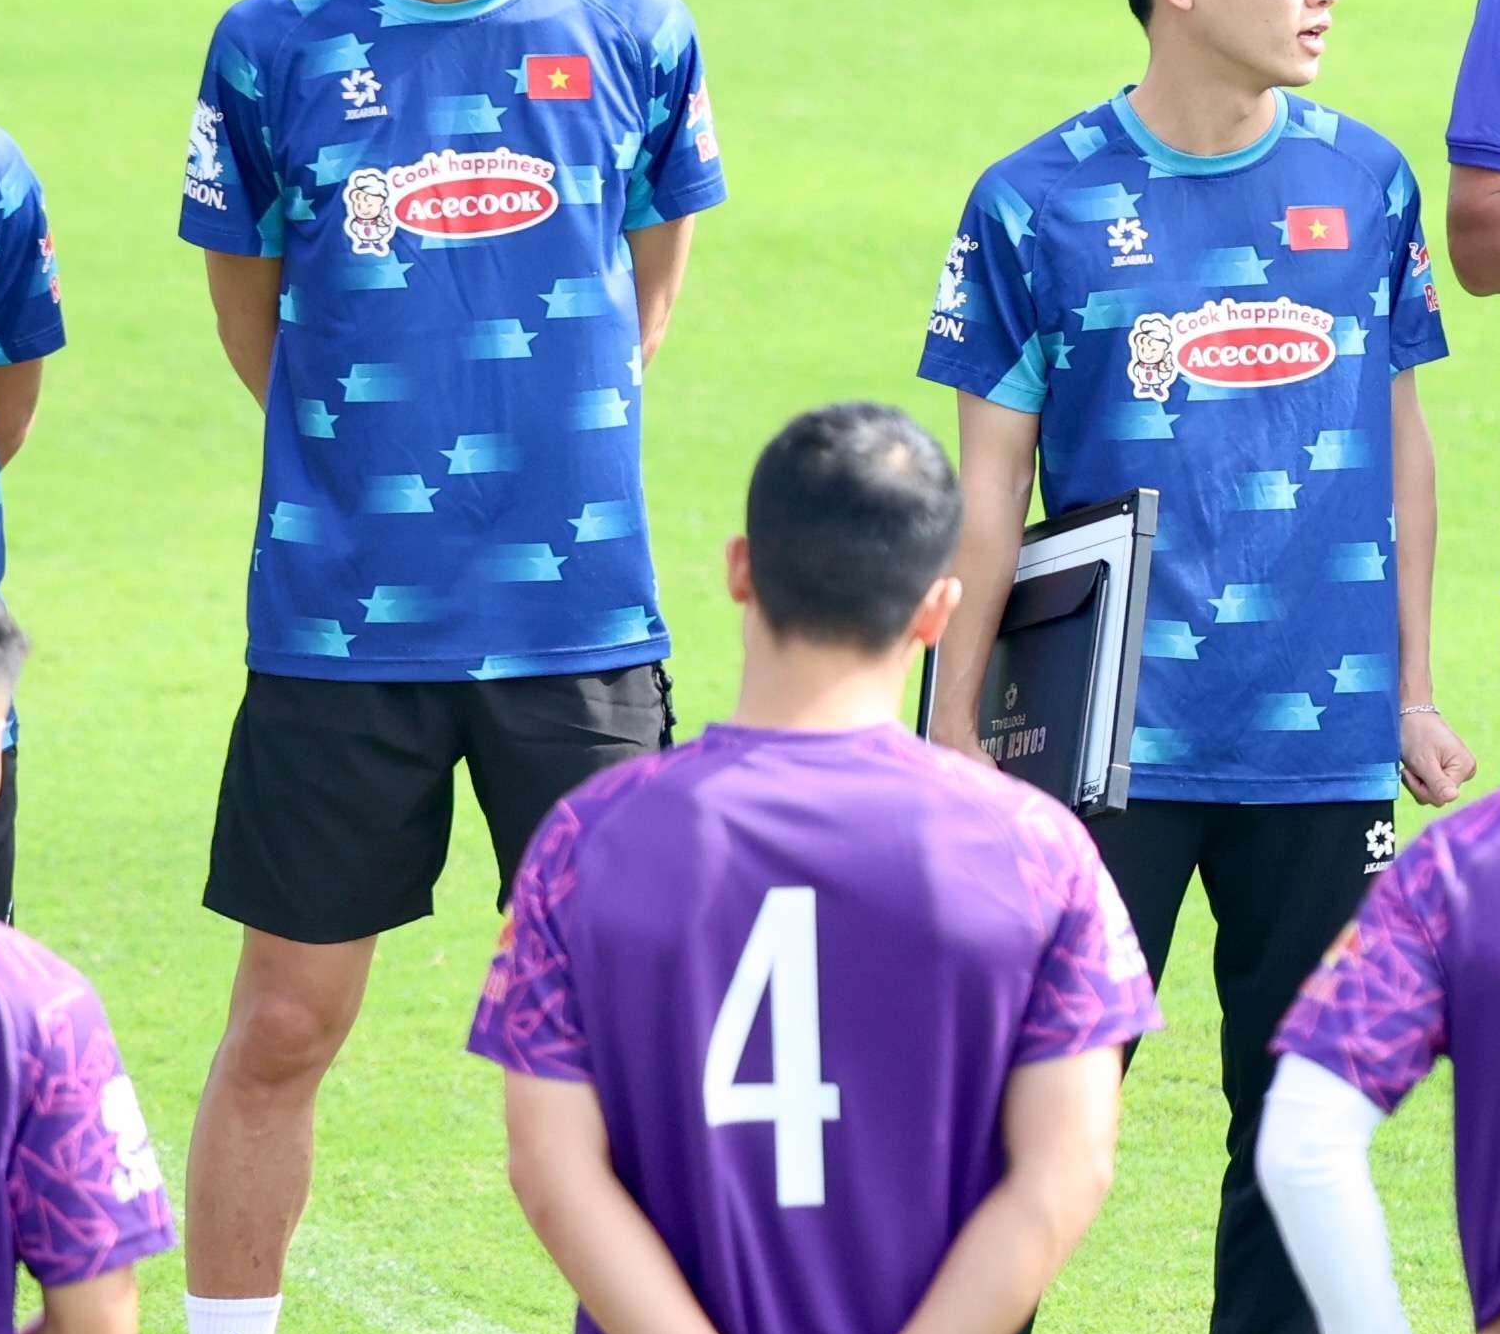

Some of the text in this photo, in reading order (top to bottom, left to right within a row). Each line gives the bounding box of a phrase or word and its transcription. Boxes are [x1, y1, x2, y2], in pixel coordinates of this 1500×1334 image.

[392, 152, 551, 188] Cook happiness
[1176, 303, 1329, 335] Cook happiness
[703, 886, 841, 1208] 4
